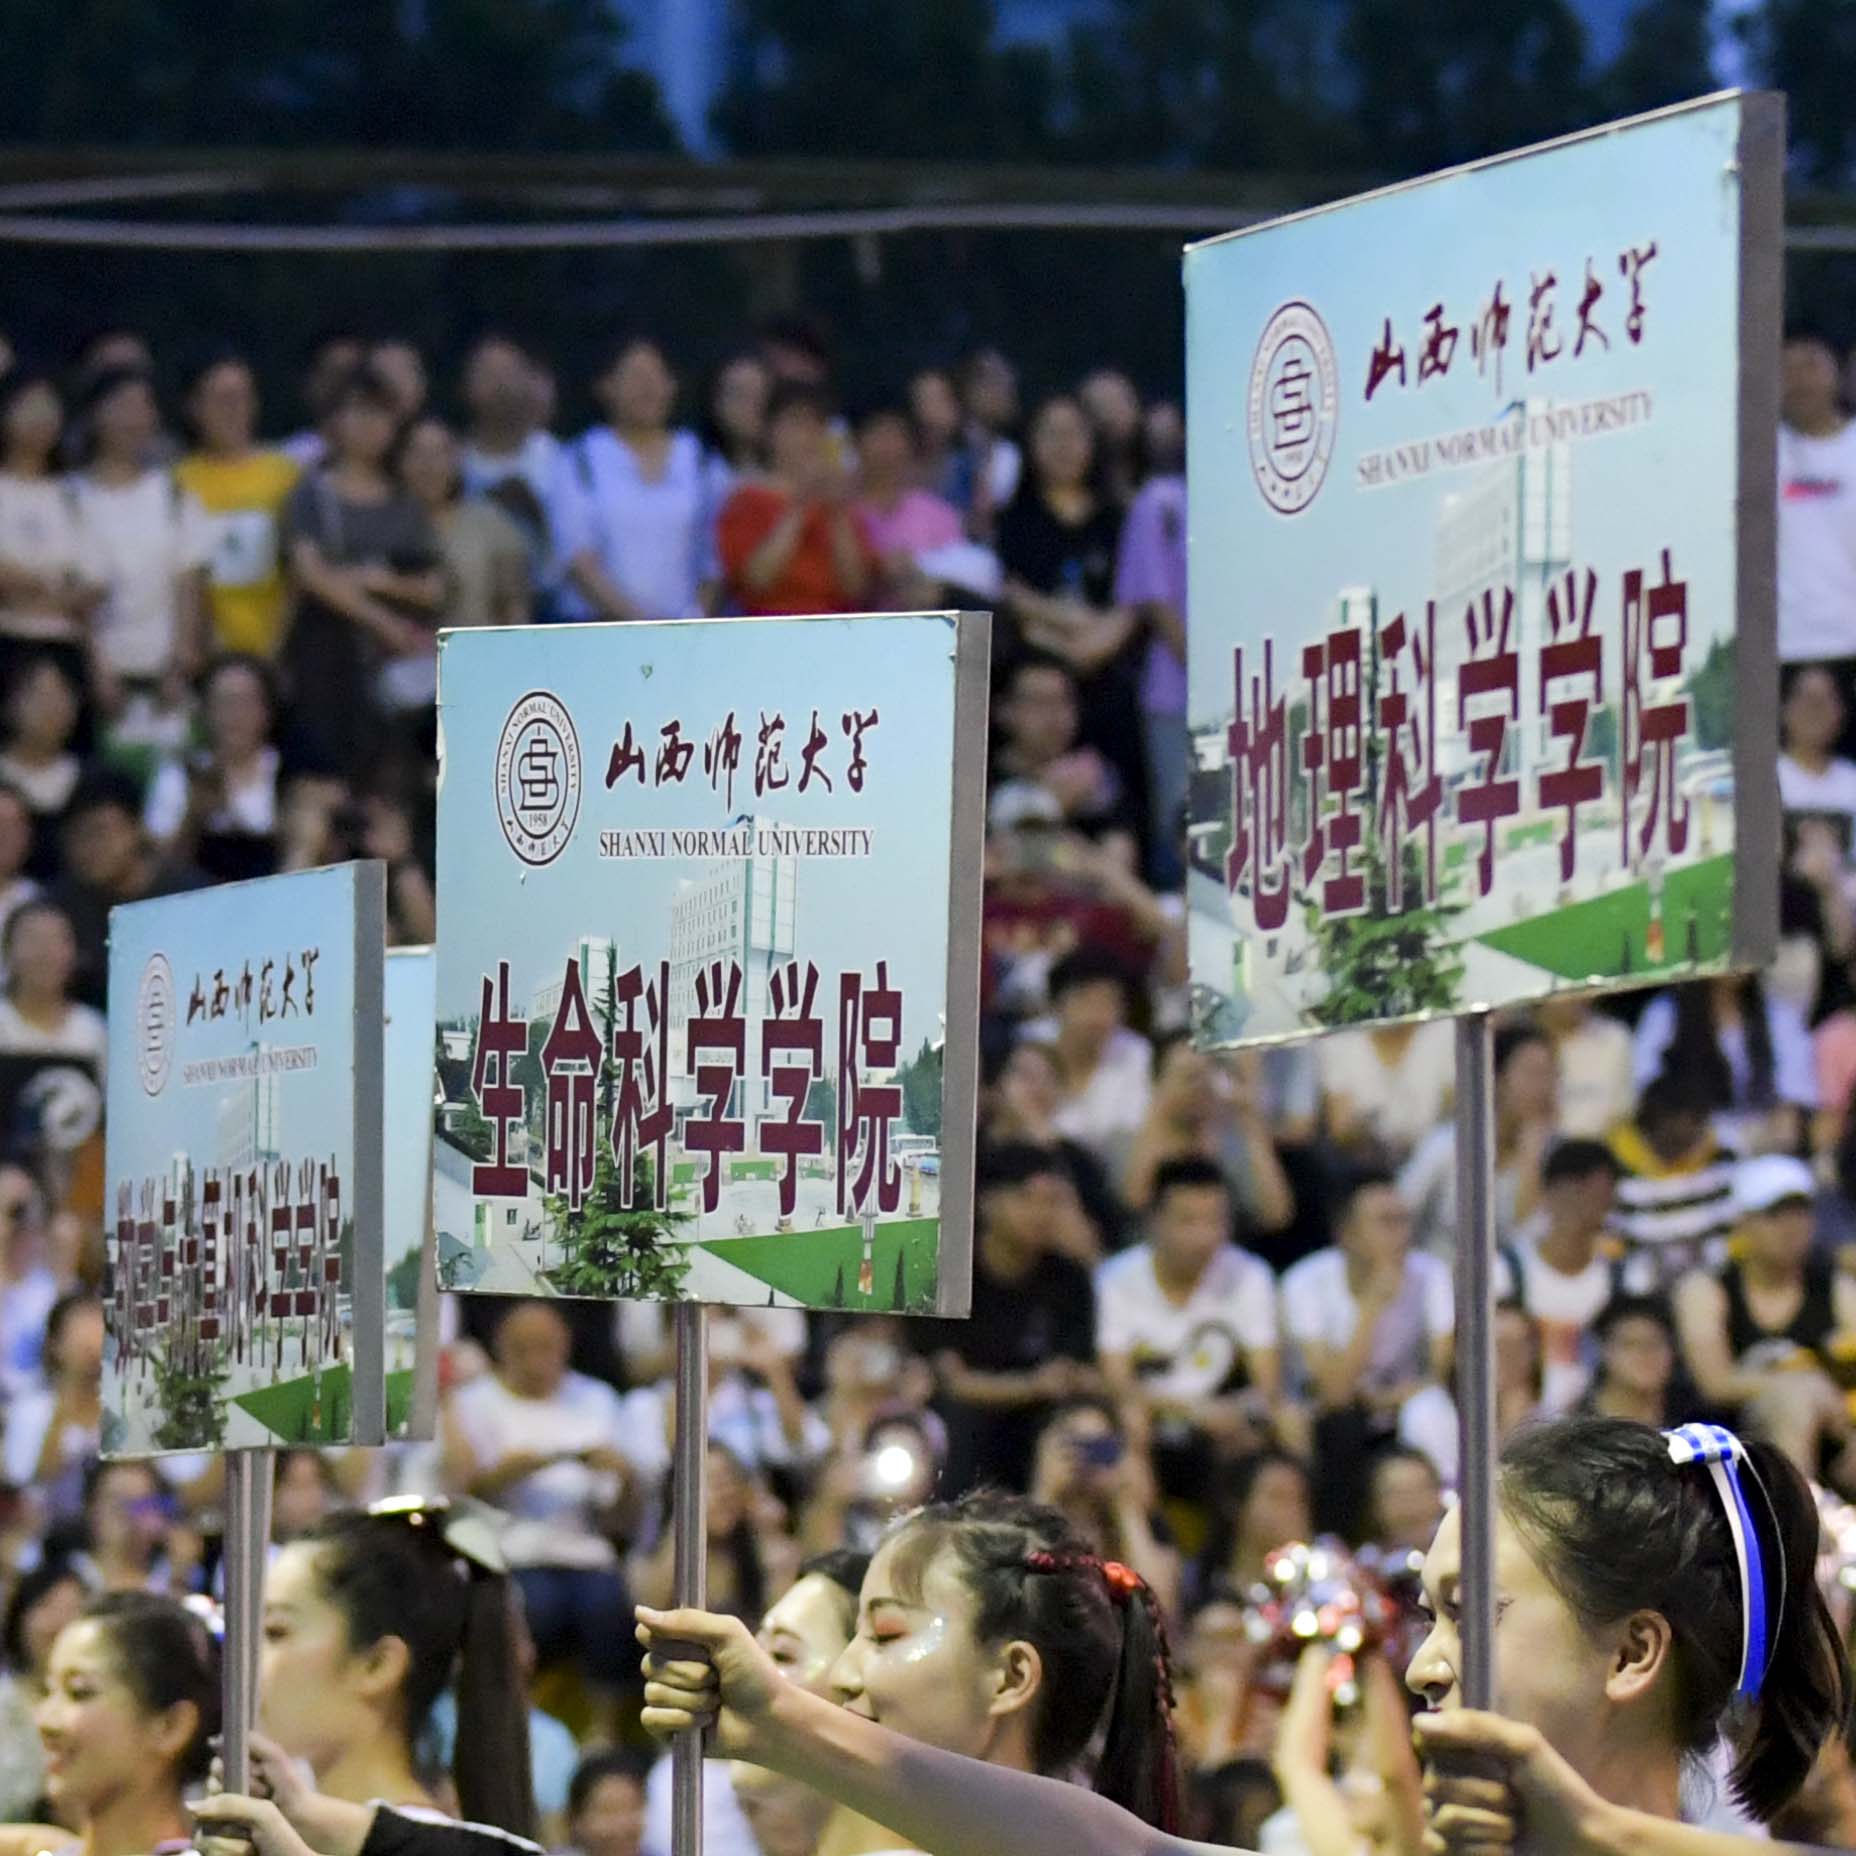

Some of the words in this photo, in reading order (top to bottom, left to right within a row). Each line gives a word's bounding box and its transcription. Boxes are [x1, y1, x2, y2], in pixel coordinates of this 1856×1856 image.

[1363, 240, 1660, 402] 山西师范大学
[604, 706, 881, 813] 山西师范大学
[1225, 546, 1693, 932] 地理科学学院
[598, 829, 665, 858] SHANXI
[671, 829, 752, 857] NORMAL
[756, 829, 874, 857] UNIVERSITY
[470, 959, 904, 1217] 生命科学学院
